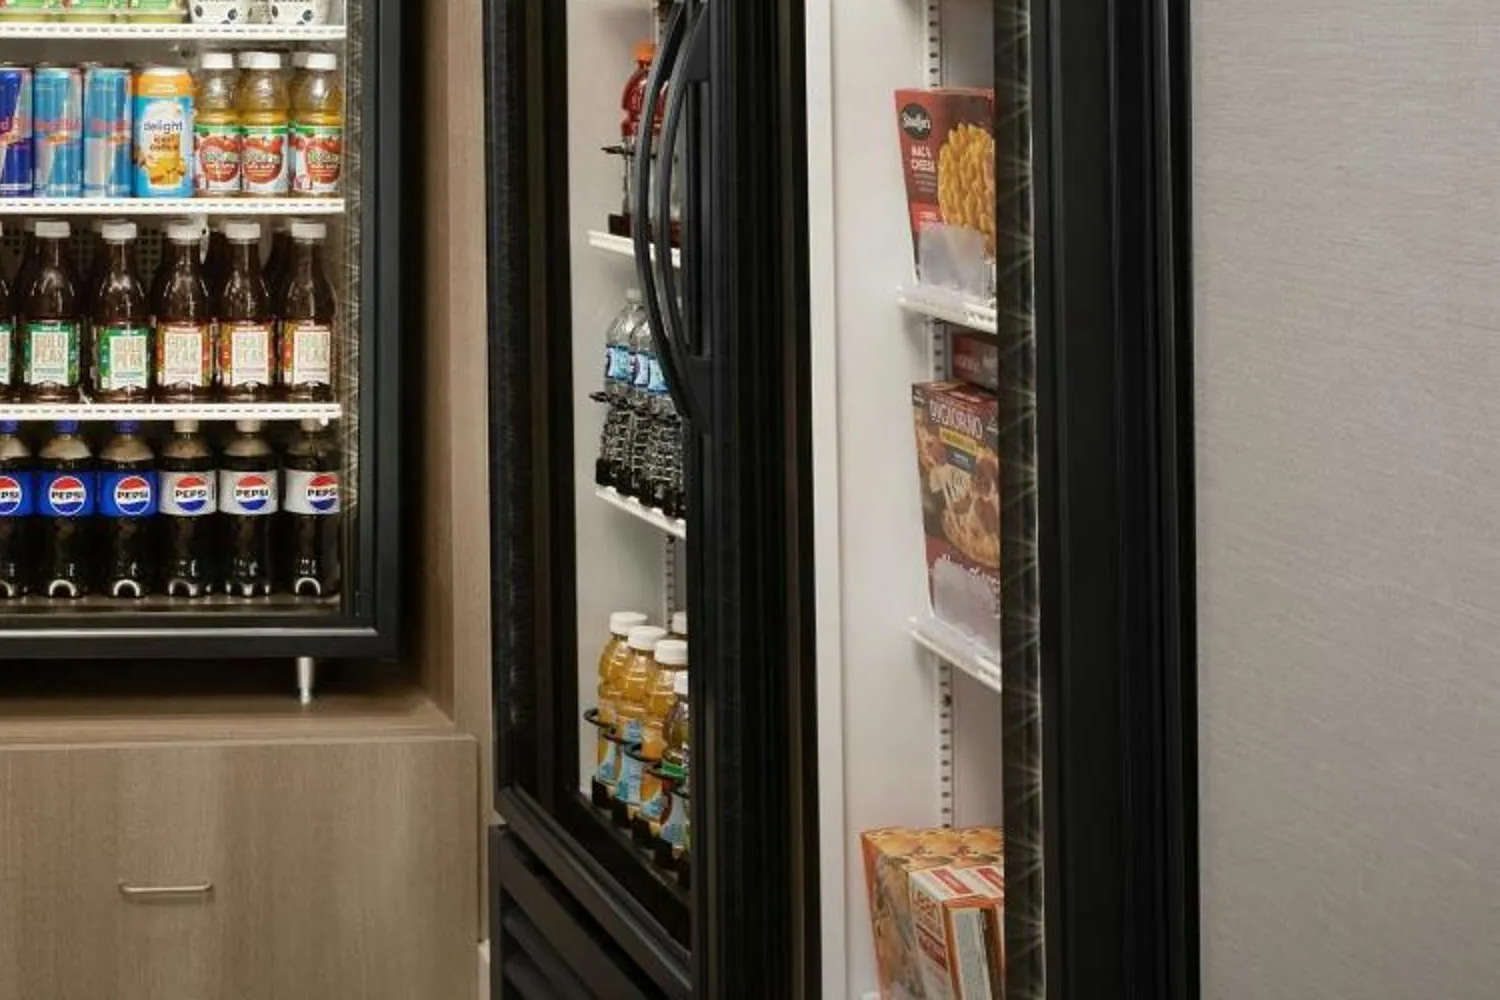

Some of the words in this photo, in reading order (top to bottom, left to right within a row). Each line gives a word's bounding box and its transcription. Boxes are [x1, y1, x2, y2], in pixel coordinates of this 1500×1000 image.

[51, 490, 84, 500] PEPSI
[117, 490, 148, 500] PEPSI
[176, 488, 207, 498] PEPSI
[235, 488, 270, 499] PEPSI
